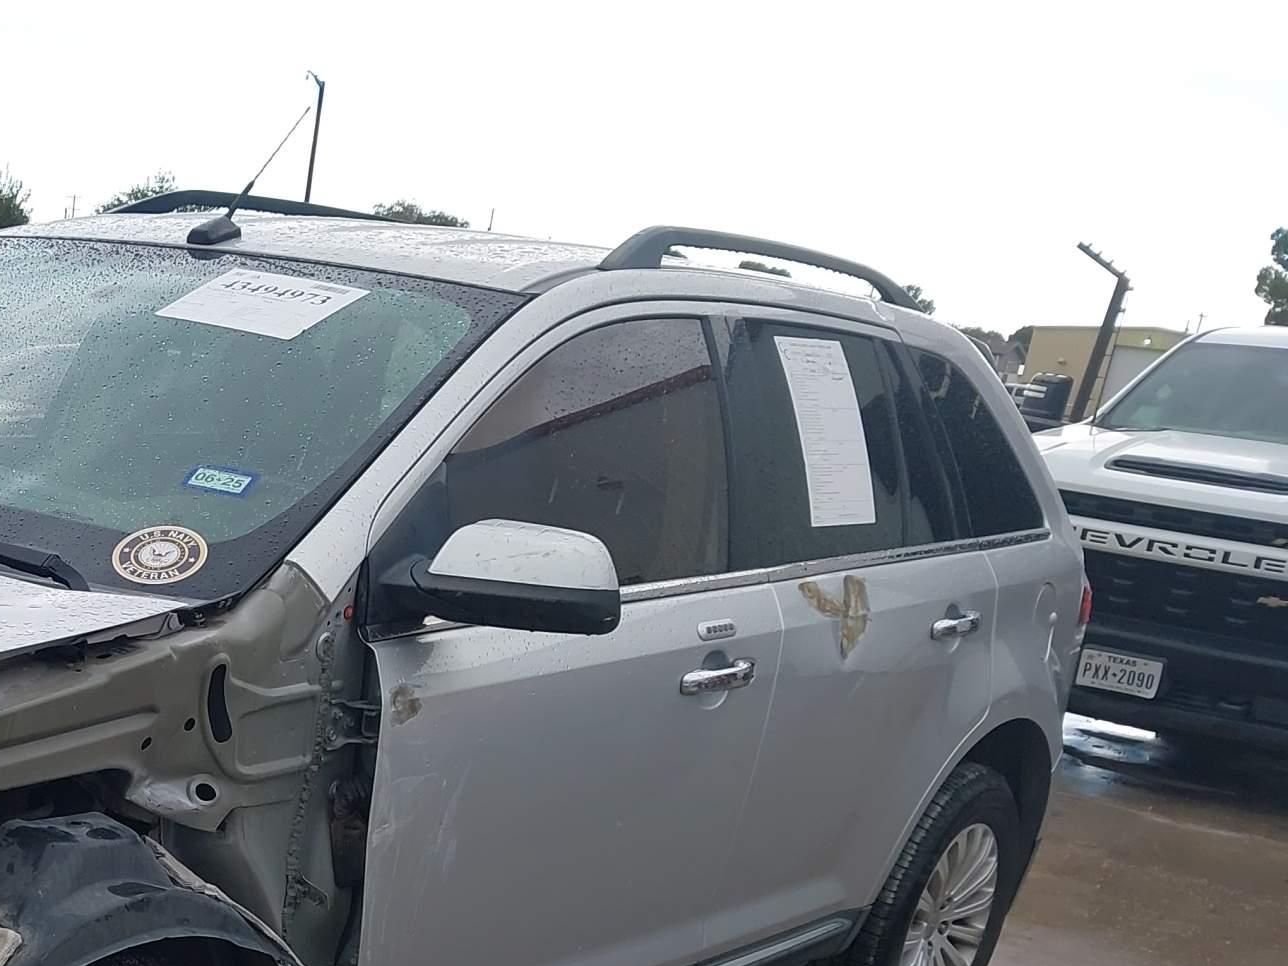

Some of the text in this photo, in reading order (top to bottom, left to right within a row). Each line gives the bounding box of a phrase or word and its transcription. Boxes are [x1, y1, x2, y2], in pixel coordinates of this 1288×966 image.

[221, 280, 333, 305] 43494973
[139, 530, 198, 548] U.S. NAVY
[121, 560, 180, 580] VETERAN
[1107, 655, 1137, 667] TEXAS
